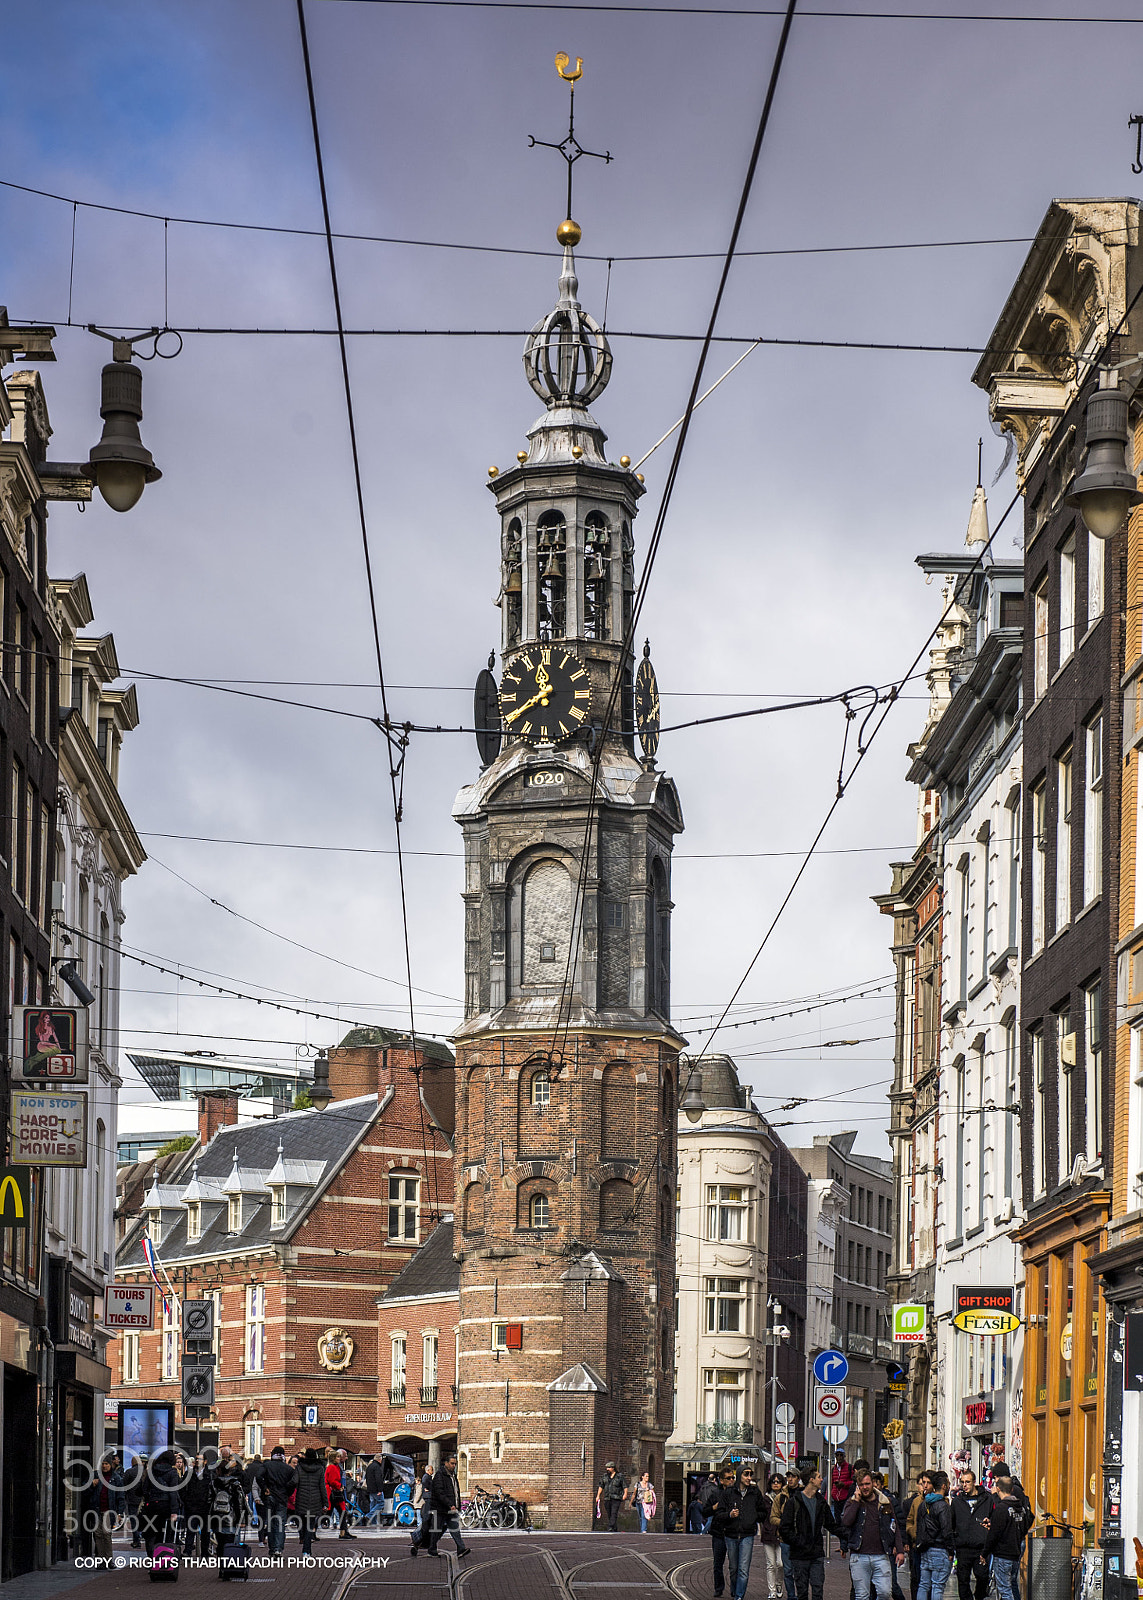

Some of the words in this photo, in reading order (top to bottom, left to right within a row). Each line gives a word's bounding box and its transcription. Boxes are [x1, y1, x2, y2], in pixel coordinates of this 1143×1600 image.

[529, 771, 564, 787] 1620
[20, 1099, 45, 1108] NON
[49, 1100, 77, 1109] STOP
[20, 1114, 58, 1127] HARD
[20, 1128, 58, 1141] CORE
[20, 1142, 76, 1156] MOVIES
[113, 1289, 146, 1301] TOURS
[124, 1302, 133, 1312] &
[958, 1296, 982, 1307] GIFT
[983, 1296, 1012, 1307] SHOP
[109, 1313, 148, 1325] TICKETS
[963, 1315, 1012, 1330] FLASH
[895, 1333, 924, 1341] maoz
[822, 1401, 838, 1411] 30
